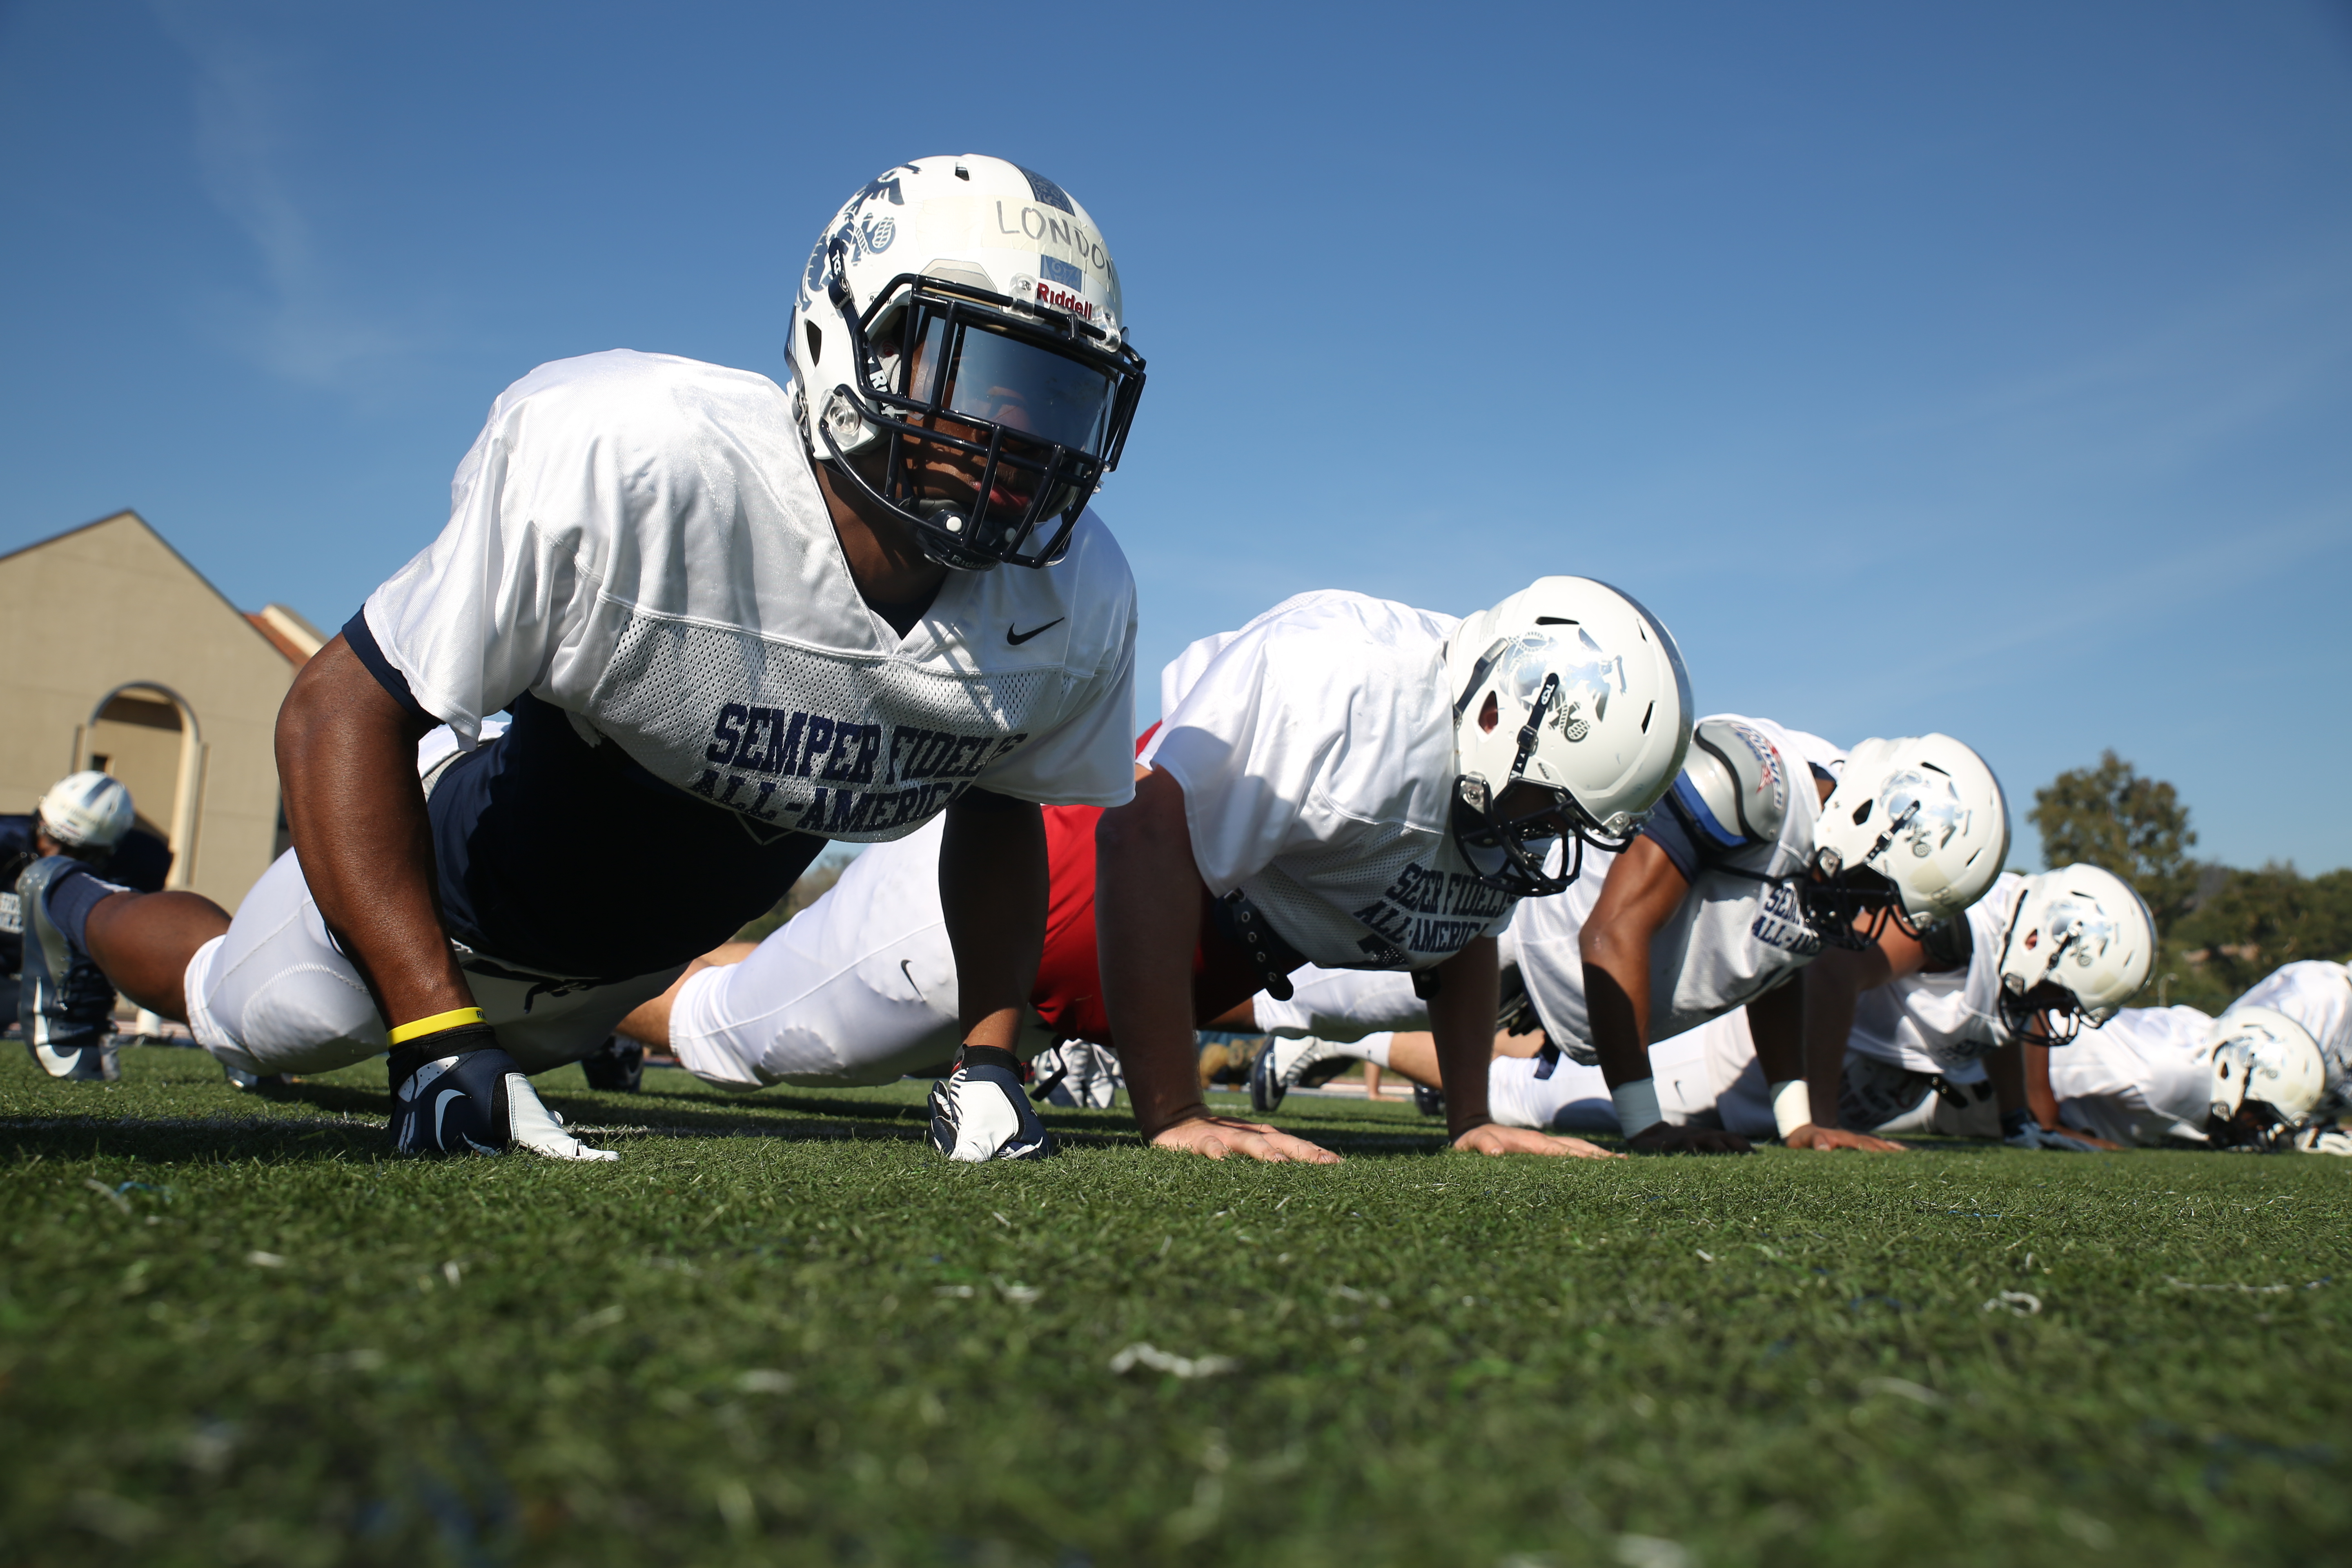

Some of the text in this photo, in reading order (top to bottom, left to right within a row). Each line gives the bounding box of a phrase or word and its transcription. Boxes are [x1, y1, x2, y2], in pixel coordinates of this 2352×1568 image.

[996, 200, 1115, 289] LONDON
[1036, 283, 1092, 321] Riddell
[951, 554, 1001, 570] Riddell
[1541, 684, 1555, 705] TCP
[706, 702, 883, 785] SEMPER
